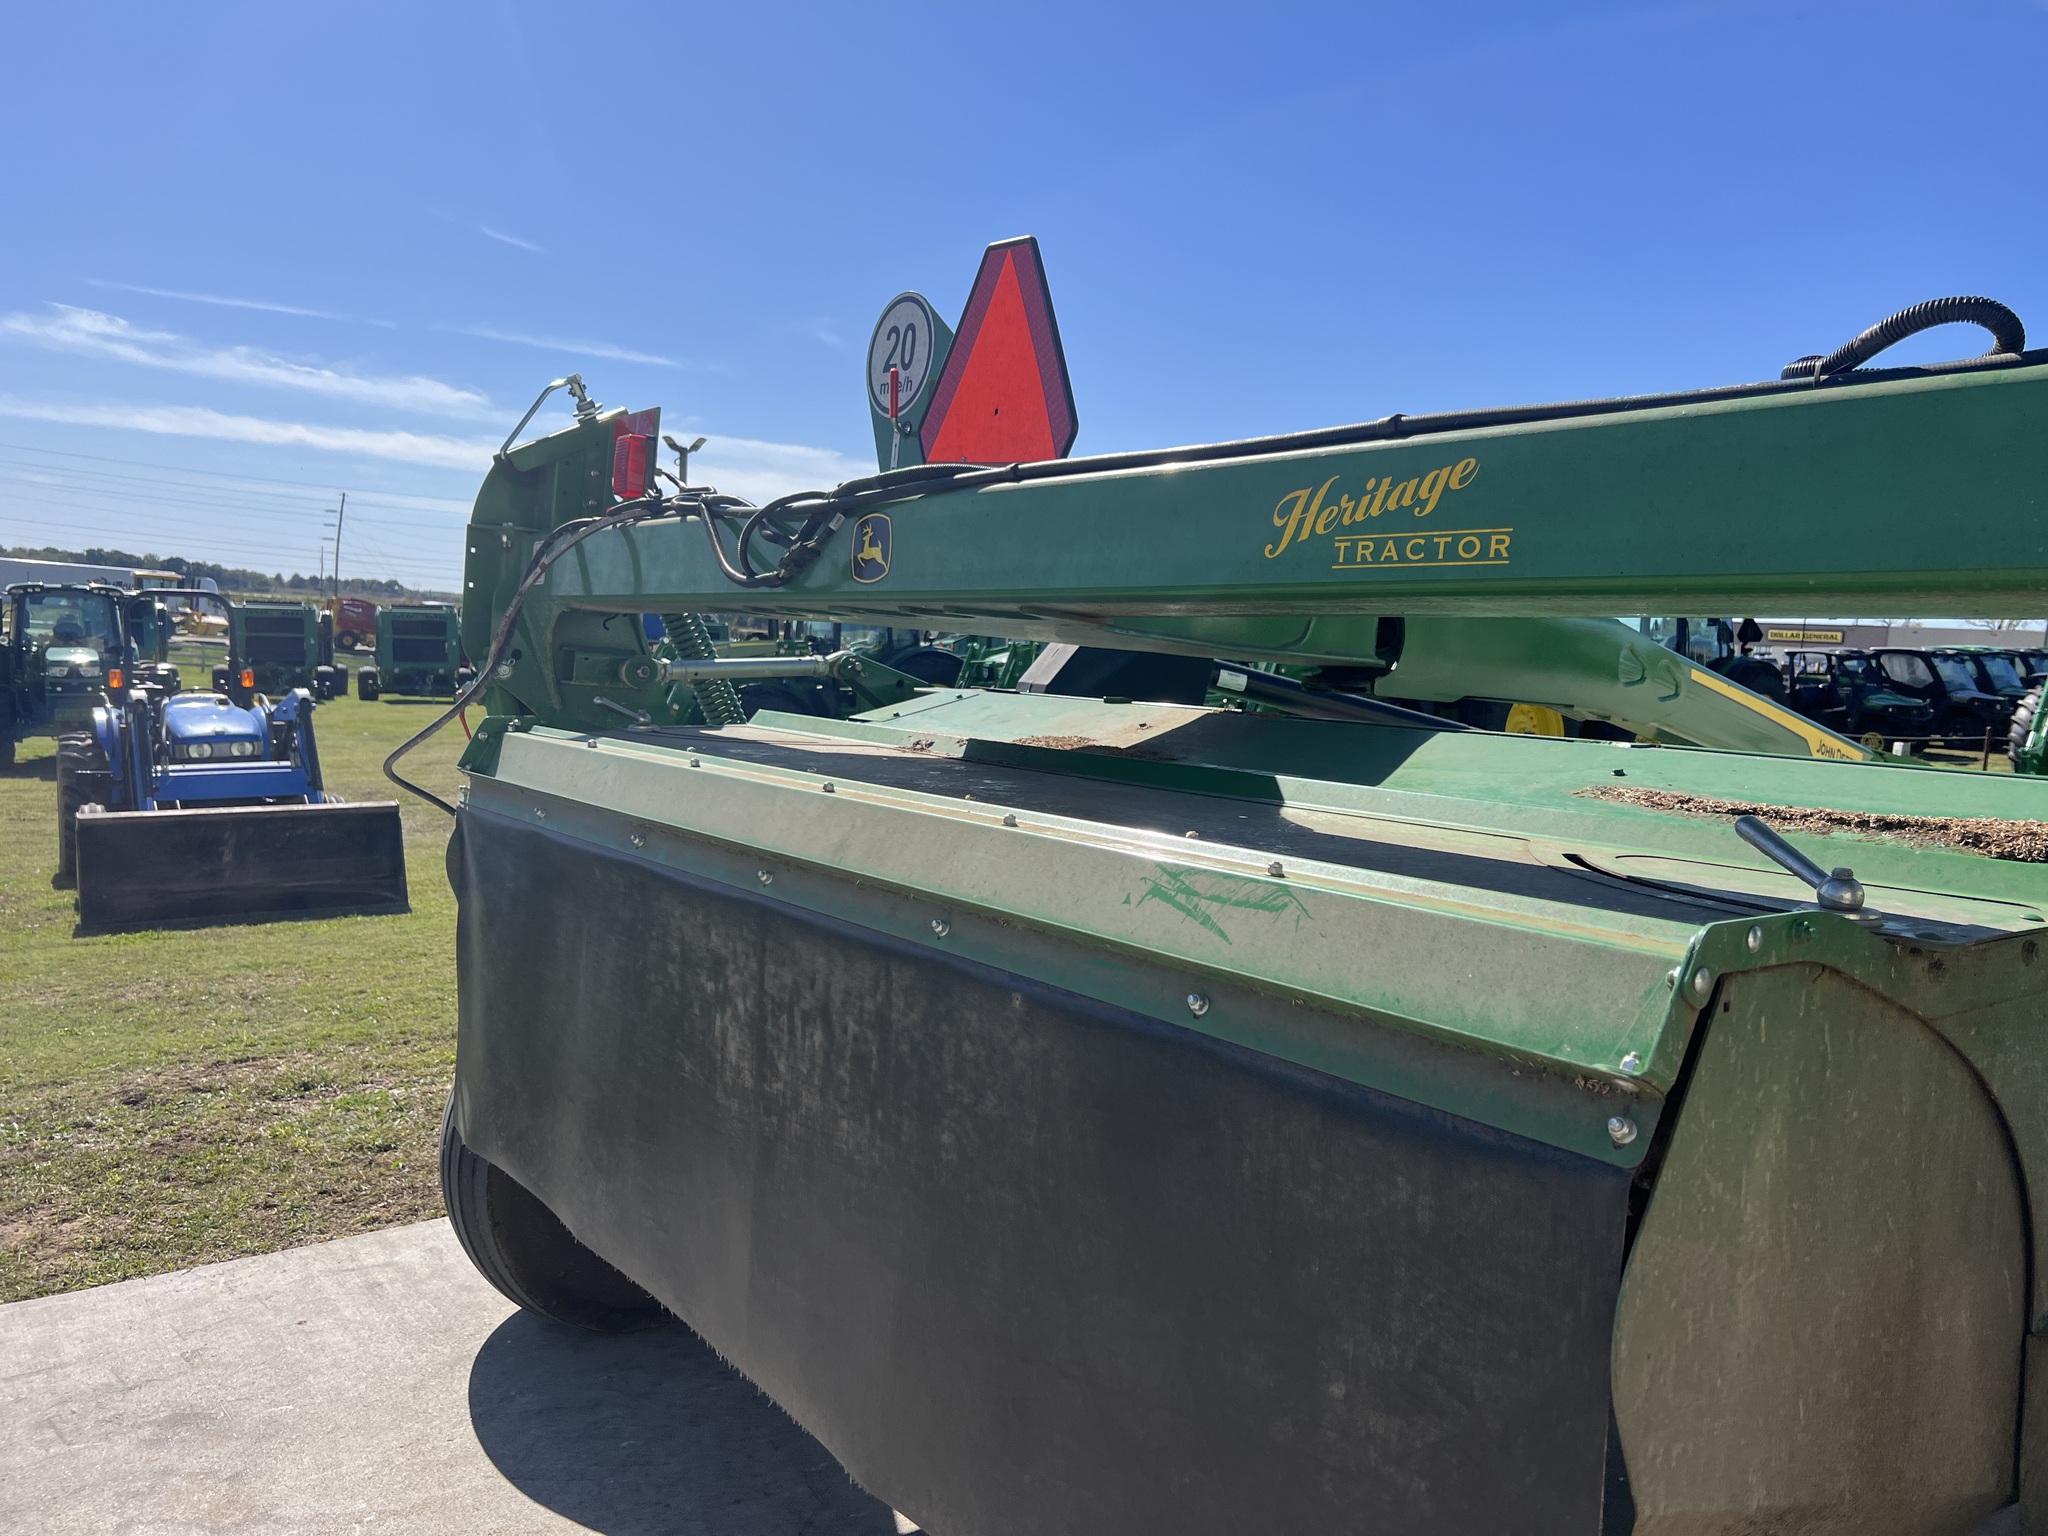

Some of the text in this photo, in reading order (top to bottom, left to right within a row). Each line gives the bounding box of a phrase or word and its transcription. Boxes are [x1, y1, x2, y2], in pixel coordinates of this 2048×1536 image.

[882, 322, 916, 374] 20
[879, 375, 913, 395] me/h
[1264, 457, 1481, 559] Heritage
[1334, 534, 1512, 563] TRACTOR
[1770, 631, 1839, 641] DOLLAR GENERAL
[1816, 738, 1836, 759] JOHN
